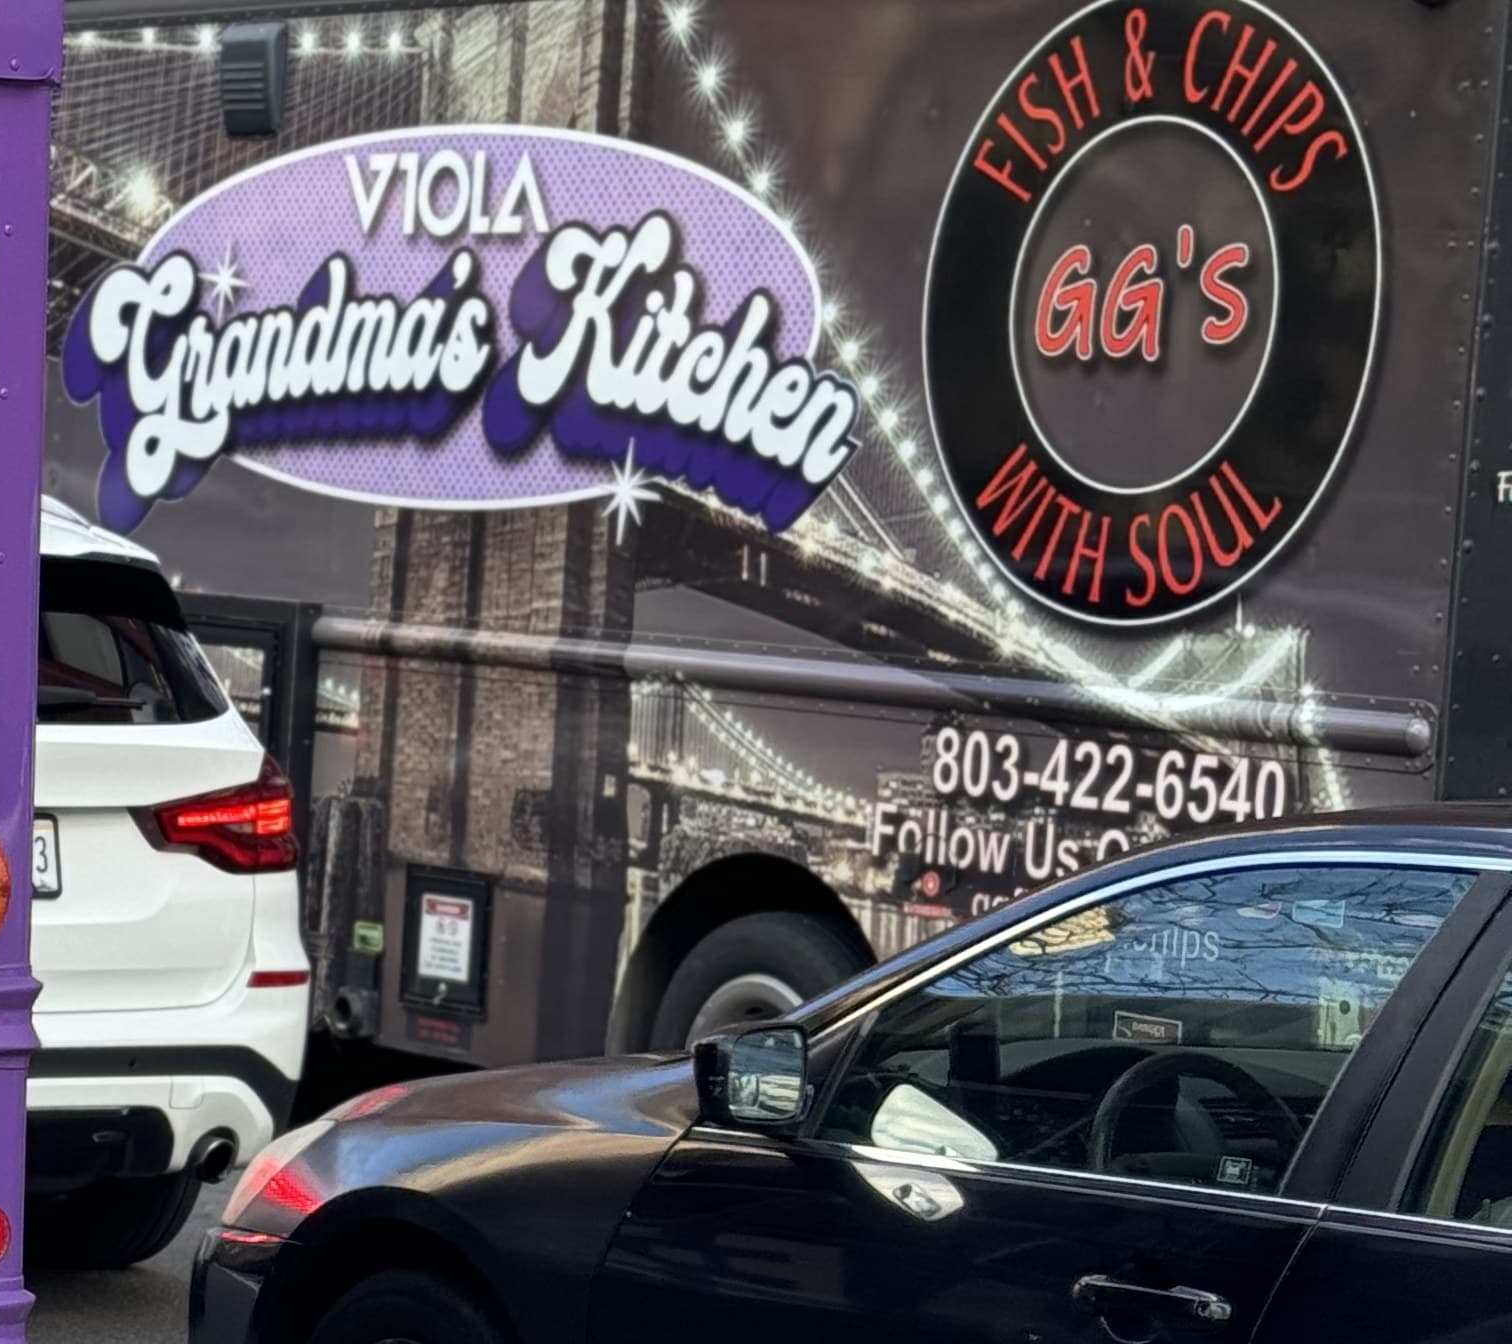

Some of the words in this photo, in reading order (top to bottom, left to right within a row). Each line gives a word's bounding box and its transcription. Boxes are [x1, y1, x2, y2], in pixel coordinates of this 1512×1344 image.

[974, 36, 1101, 203] FISH
[1124, 8, 1156, 103] &
[1183, 9, 1348, 193] CHIPS
[90, 250, 490, 497] Grandma's
[517, 214, 850, 485] Kitchen
[976, 442, 1112, 603] WITH
[1125, 460, 1284, 607] SOUL
[871, 802, 1011, 875] Follow
[1024, 817, 1080, 881] Us
[932, 726, 1287, 824] 803-422-6540
